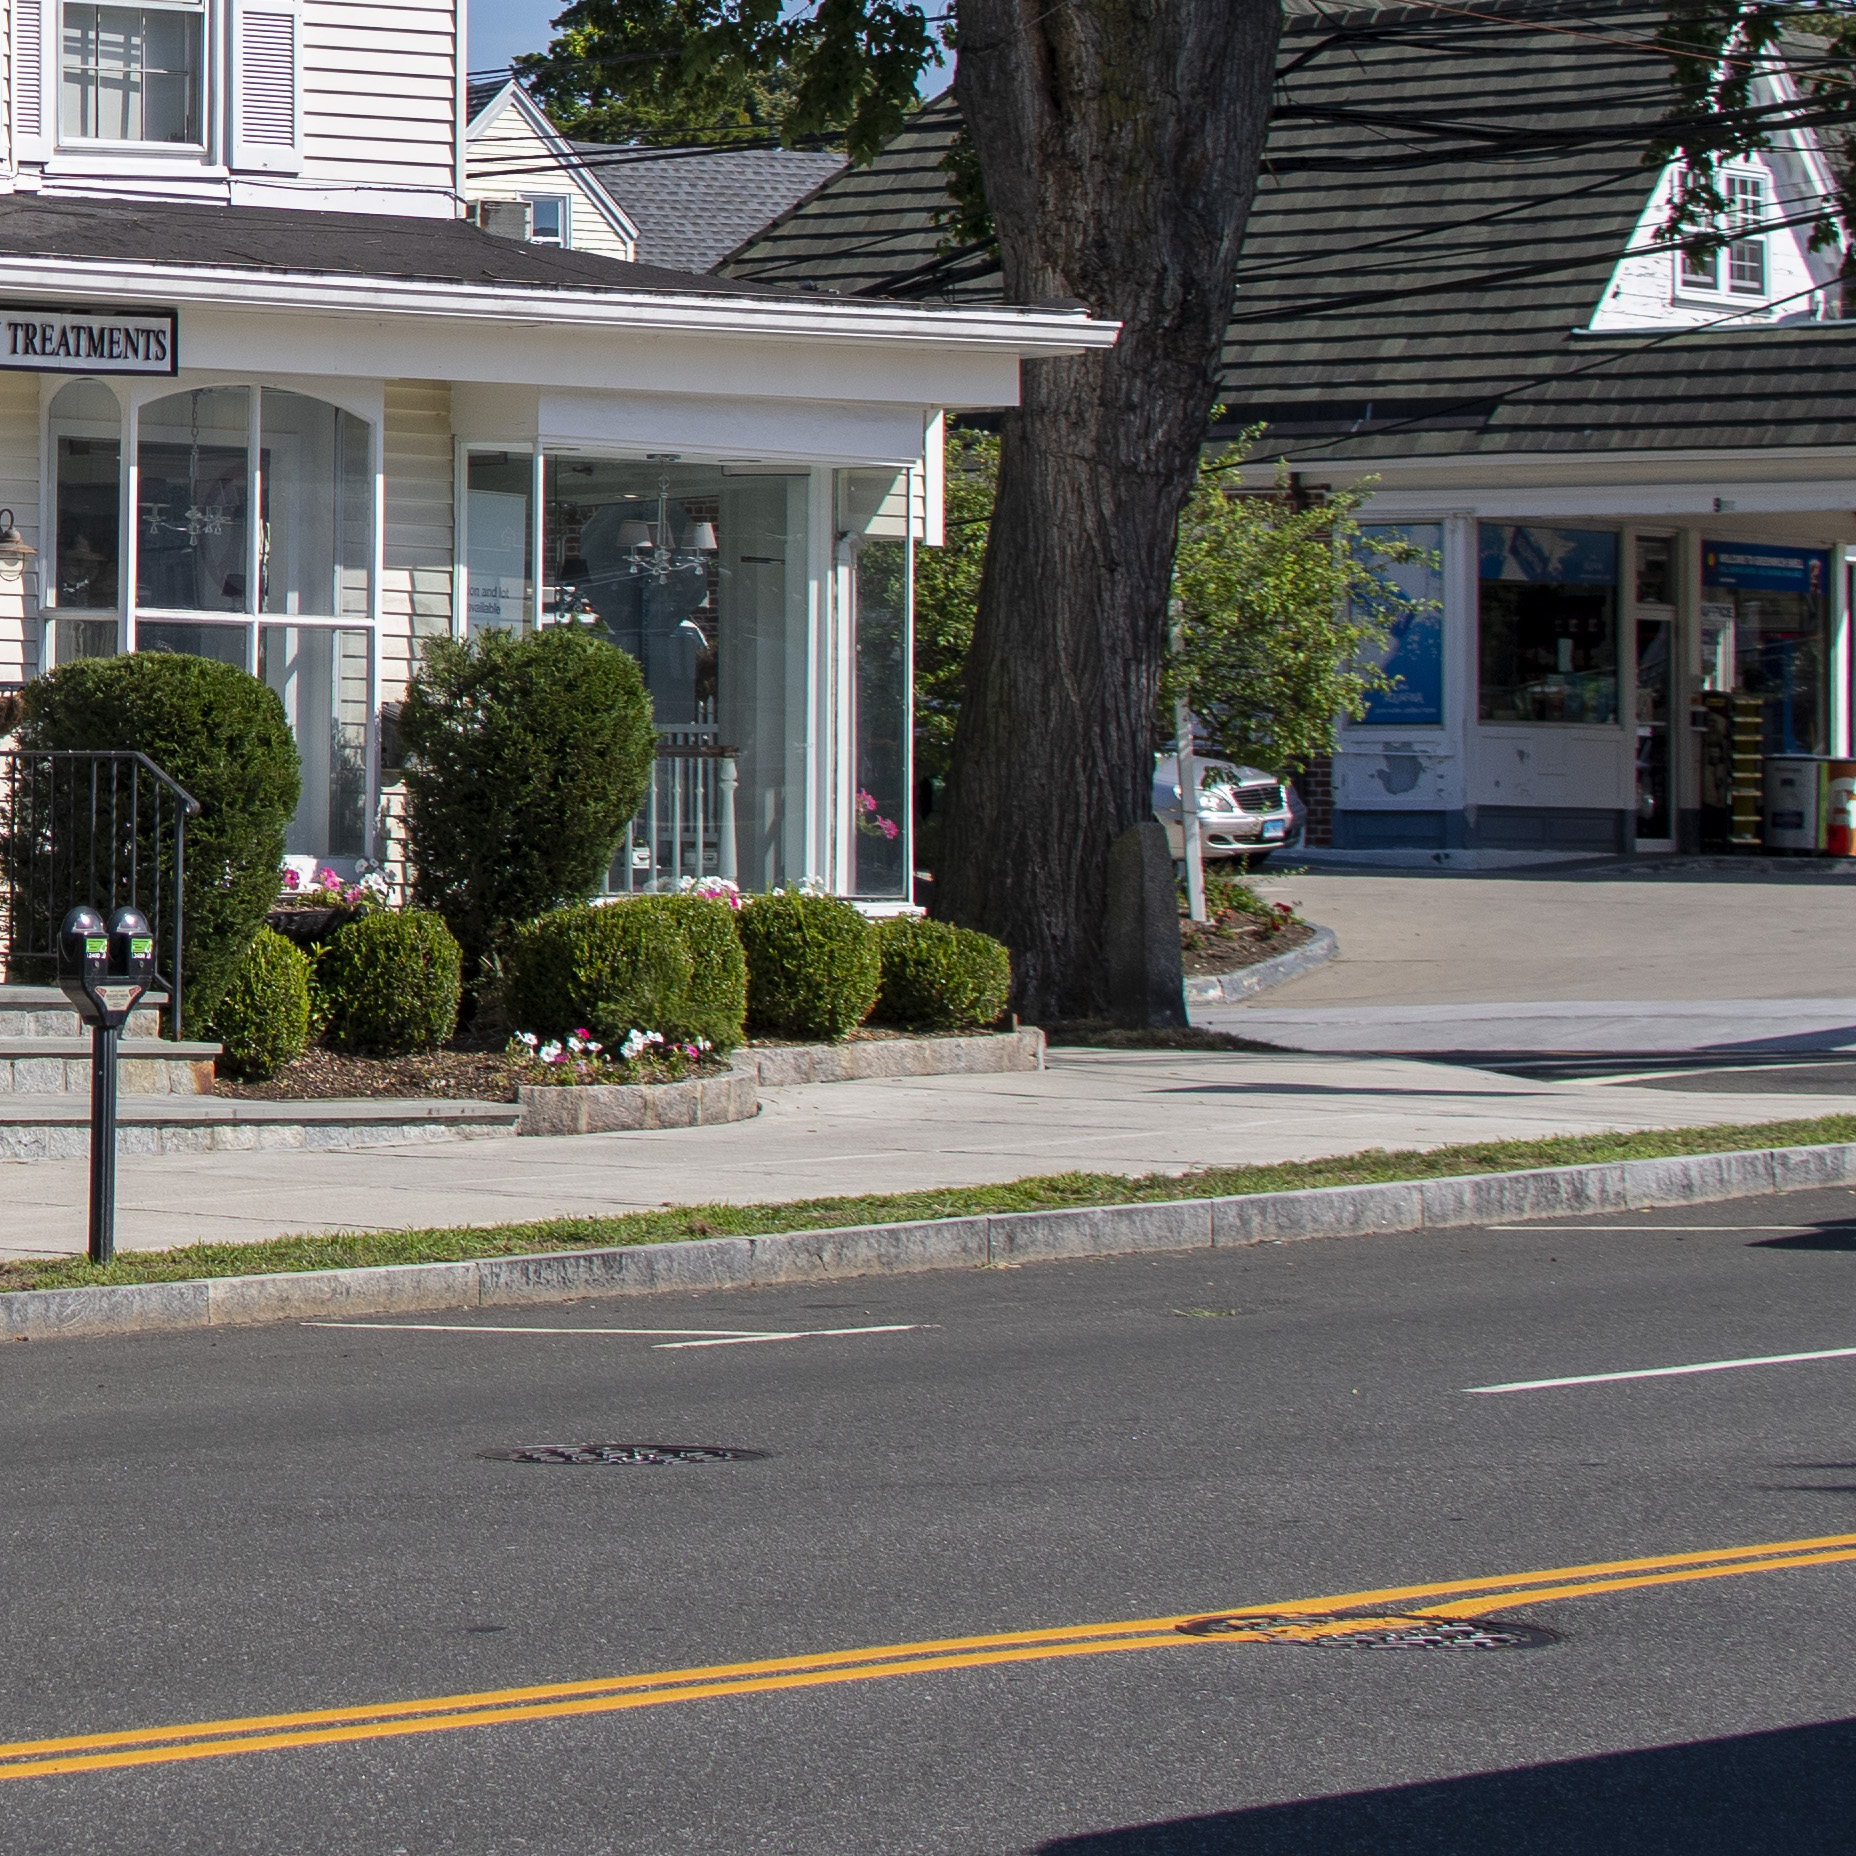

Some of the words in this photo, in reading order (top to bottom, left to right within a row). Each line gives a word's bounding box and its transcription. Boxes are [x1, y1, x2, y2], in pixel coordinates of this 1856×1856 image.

[7, 322, 168, 362] TREATMENTS
[481, 585, 497, 597] and
[498, 586, 510, 599] lot
